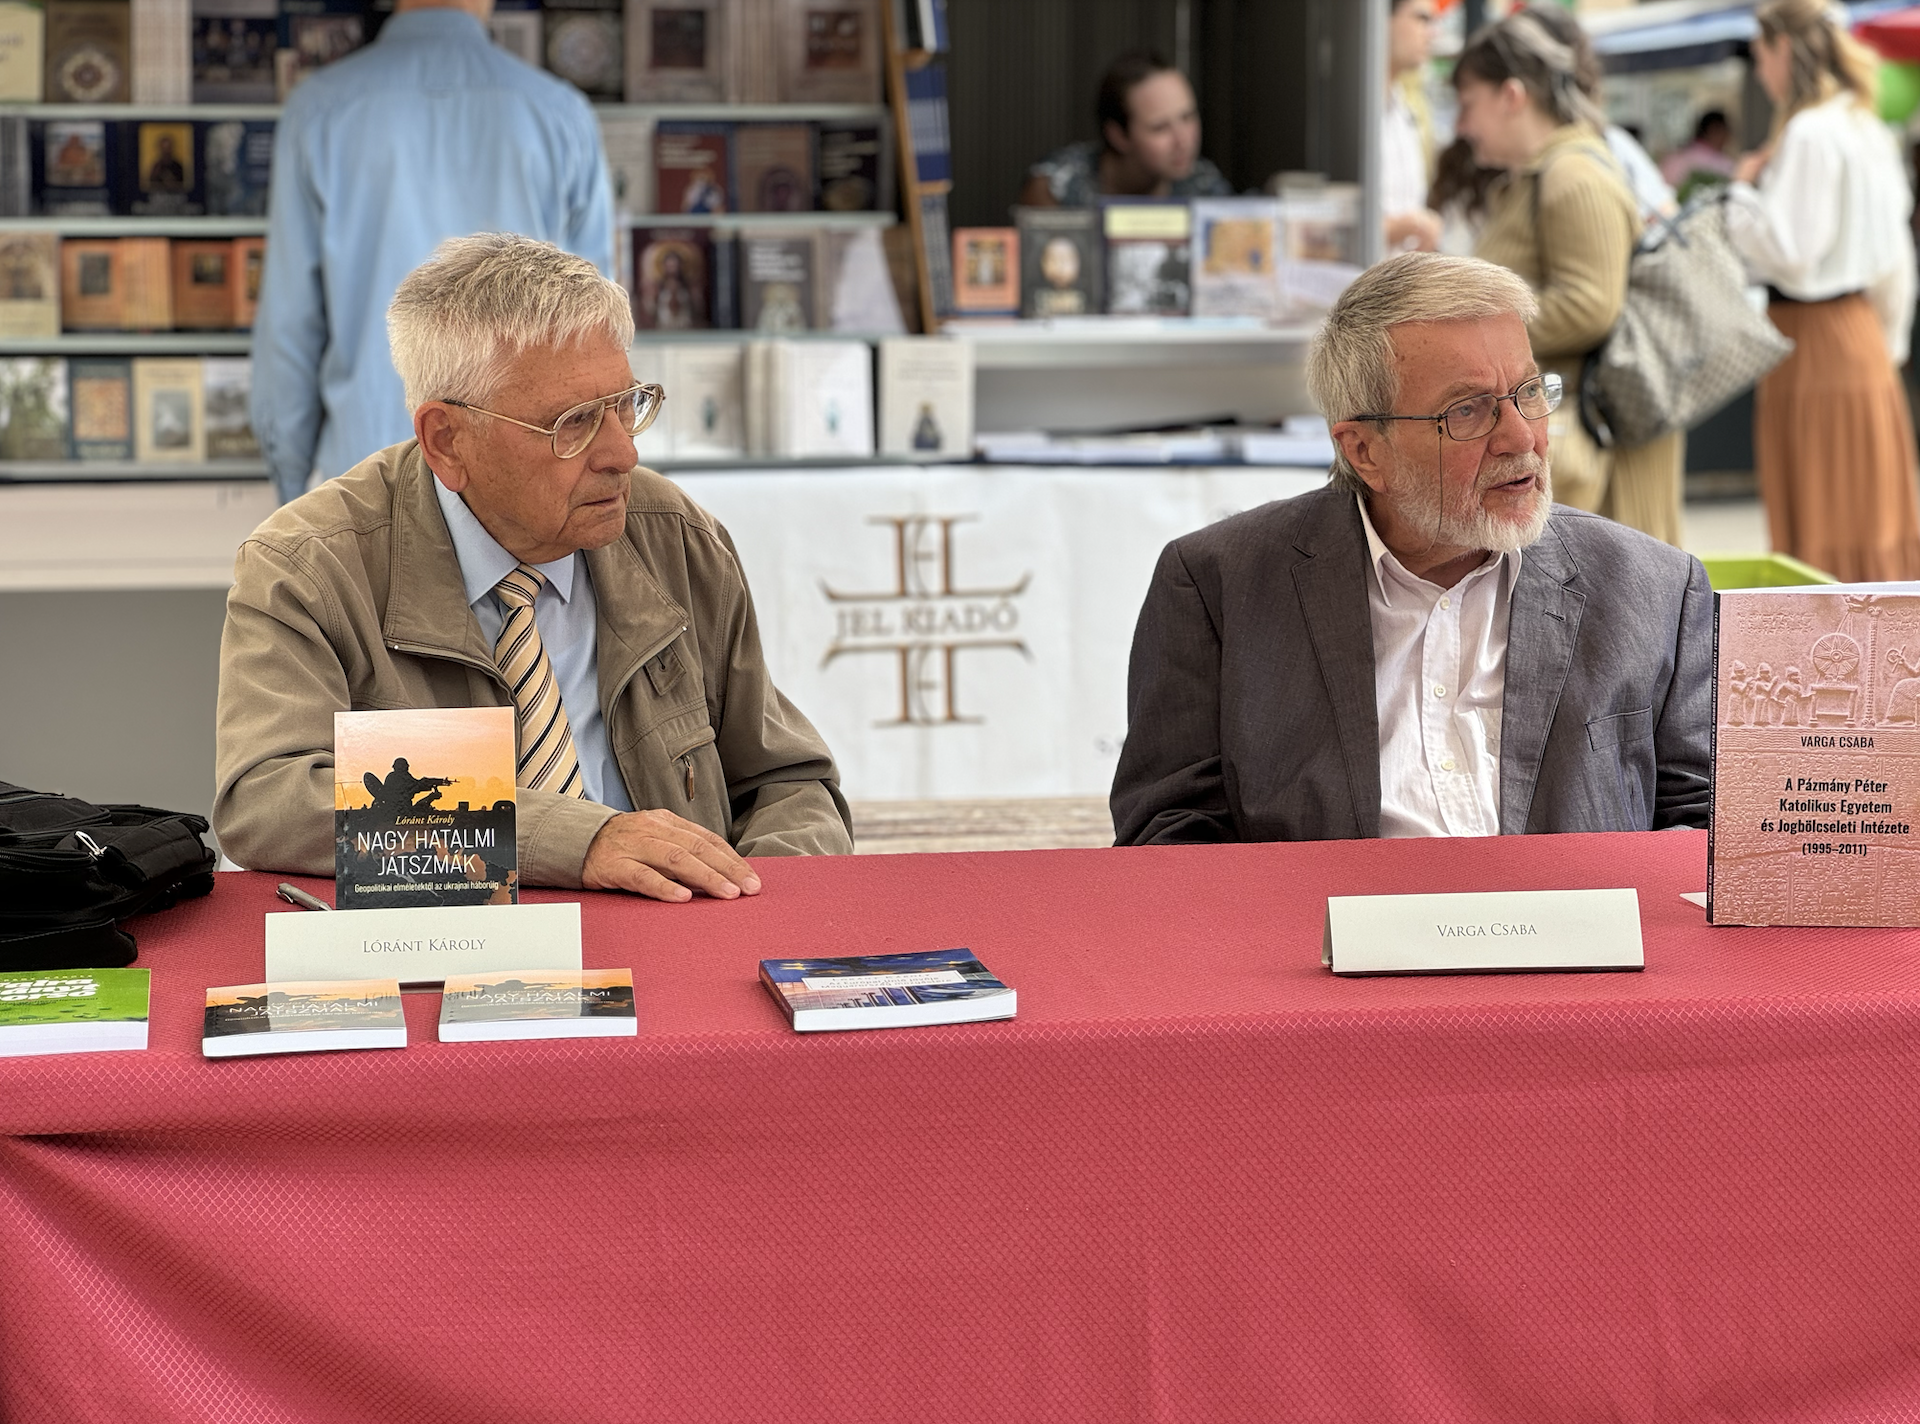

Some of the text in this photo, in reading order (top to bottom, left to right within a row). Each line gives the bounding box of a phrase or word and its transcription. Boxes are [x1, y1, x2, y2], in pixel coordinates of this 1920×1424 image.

[836, 599, 1019, 640] JEL KIADÓ
[1801, 736, 1875, 749] VARGA CSABA
[1785, 778, 1888, 794] A Pázmány Péter
[1779, 798, 1892, 815] Katolikus Egyetem
[395, 814, 455, 826] Lóránt Károly
[1761, 818, 1910, 835] és Jogbölcseleti Intézete
[357, 828, 495, 851] NAGY HATALMI
[377, 850, 476, 876] JÁTSZMÁK
[354, 880, 500, 894] Geopolitikai elméletektől az ukrajnai háborúig
[1436, 922, 1538, 938] VARGA CSABA
[363, 938, 486, 953] LÓRÁNT KÁROLY
